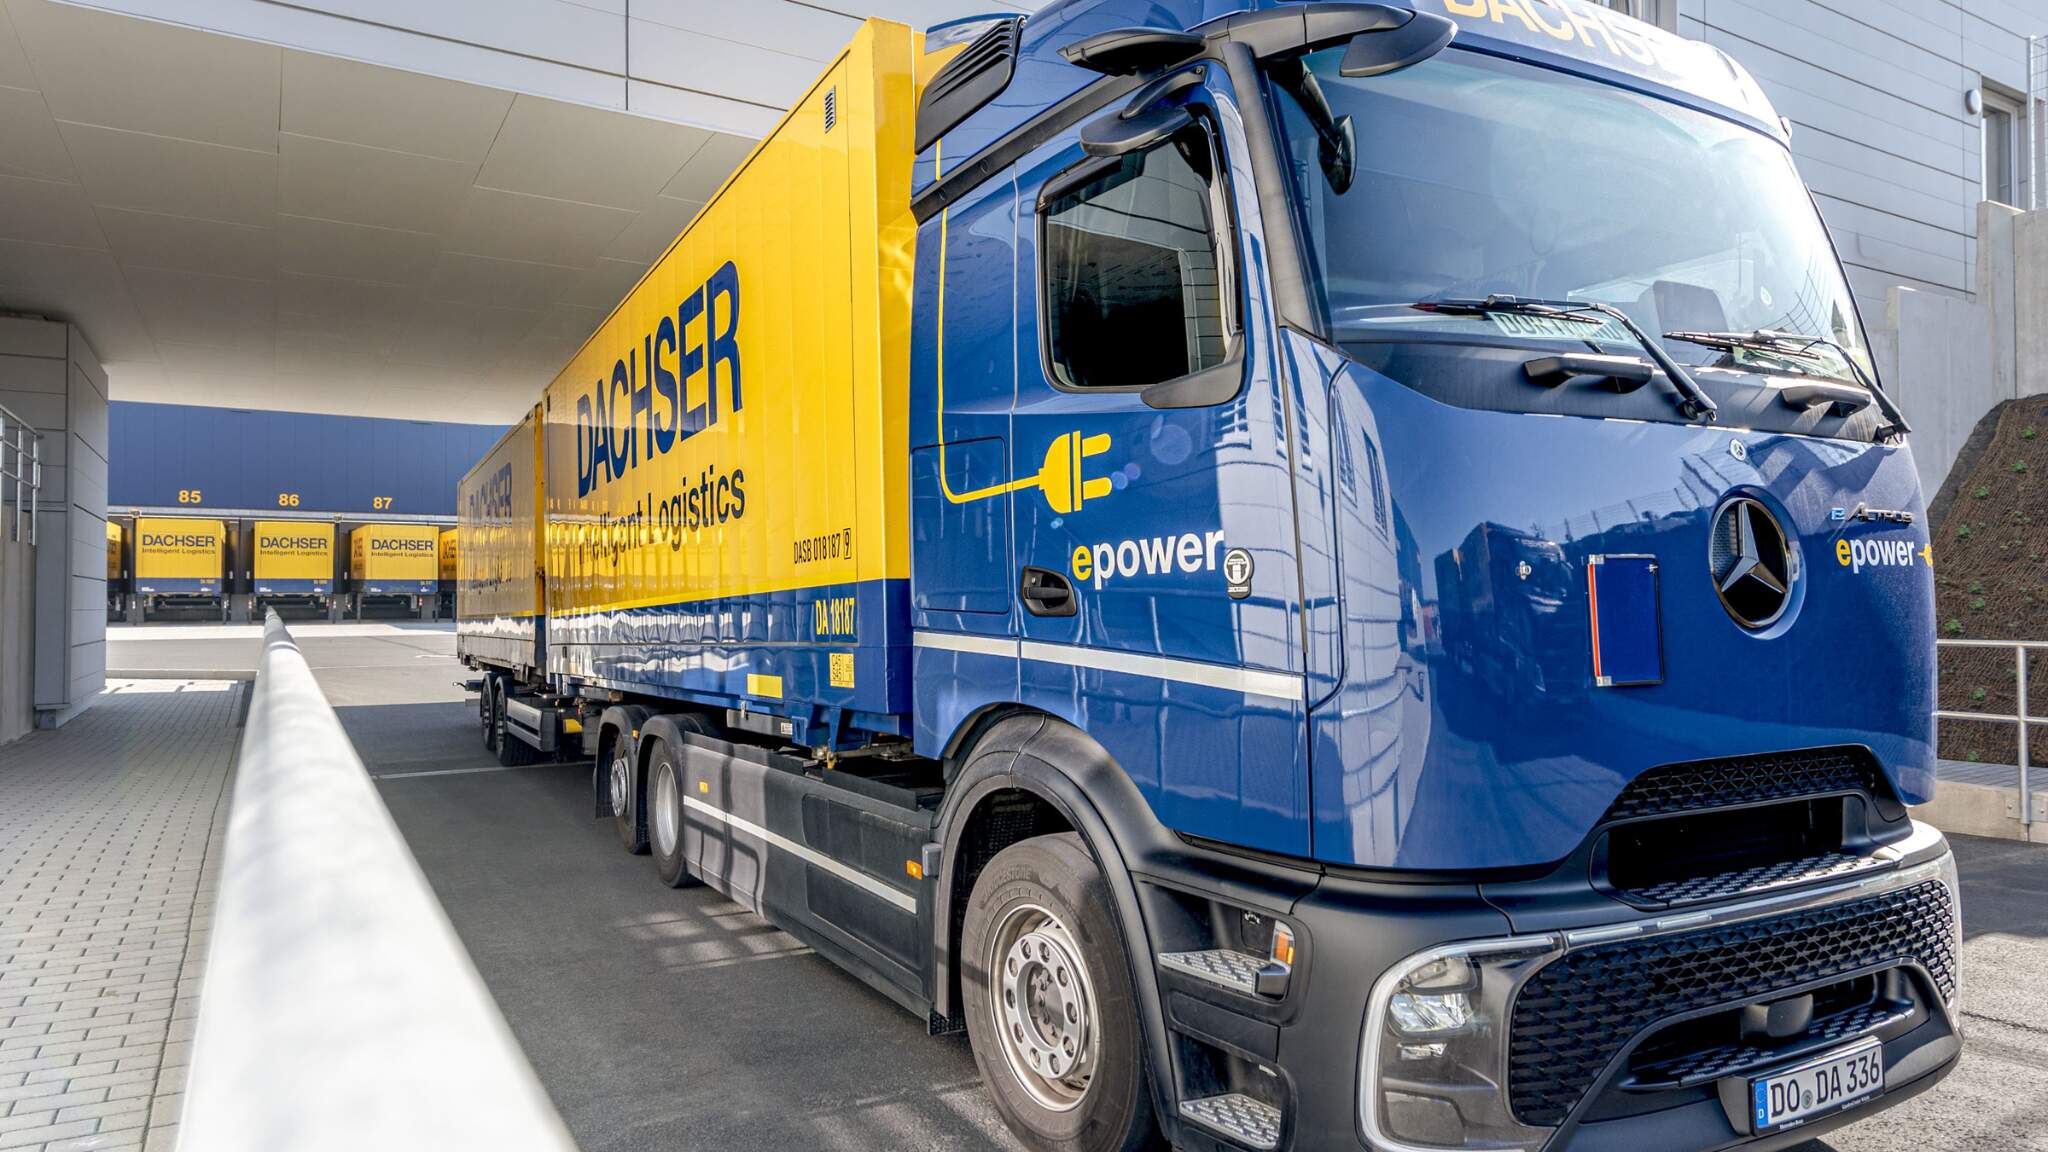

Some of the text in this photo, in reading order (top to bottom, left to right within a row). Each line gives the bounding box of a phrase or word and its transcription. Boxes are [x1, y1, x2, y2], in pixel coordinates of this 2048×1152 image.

[577, 260, 743, 499] DACHSER
[178, 490, 202, 503] 85
[278, 493, 300, 506] 86
[373, 496, 393, 509] 87
[647, 464, 745, 551] Logistics
[142, 534, 216, 547] DACHSER
[260, 537, 328, 549] DACHSER
[371, 539, 434, 551] DACHSER
[814, 533, 841, 561] 018187
[1072, 530, 1225, 590] epower
[1836, 538, 1915, 574] epower
[815, 597, 855, 635] DA 18187
[1758, 1051, 1880, 1119] D DO DA 336
